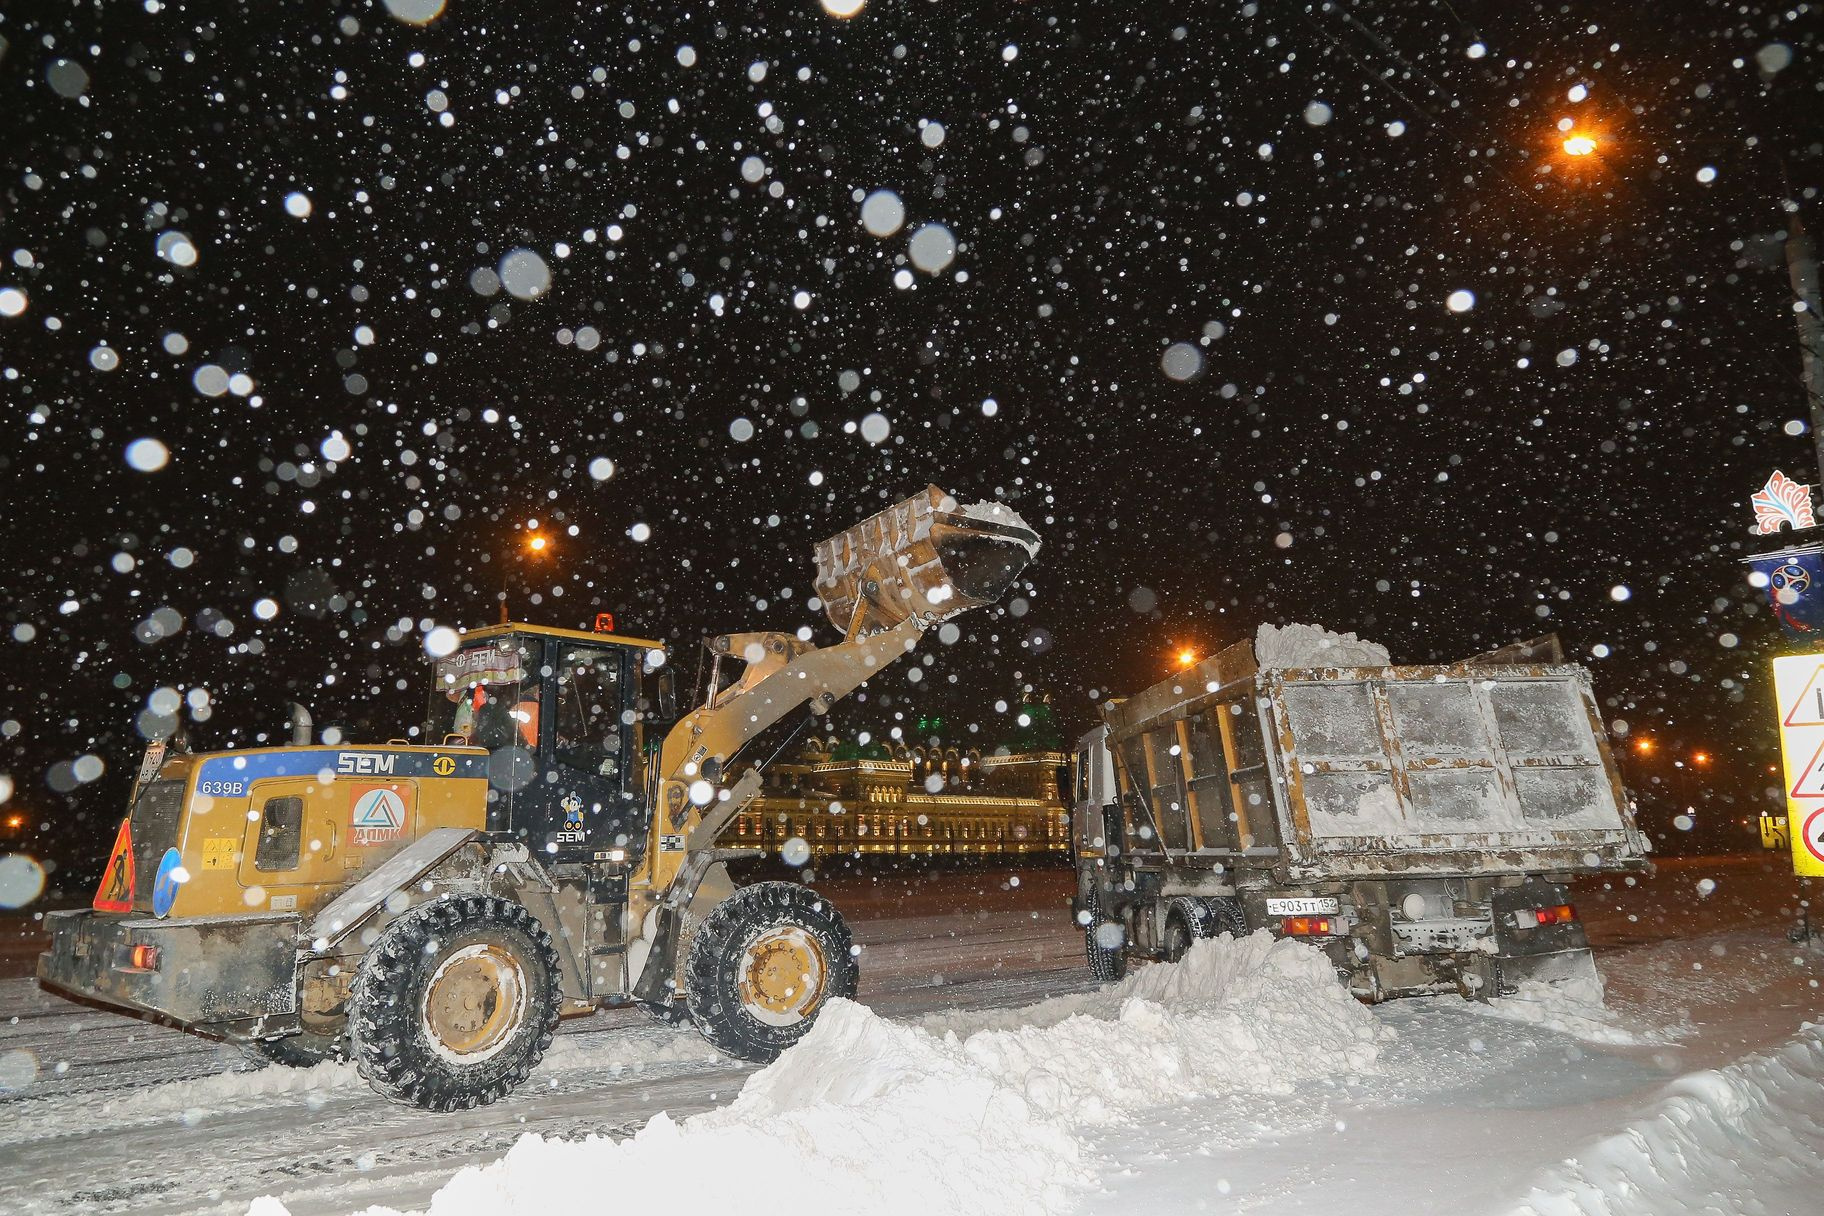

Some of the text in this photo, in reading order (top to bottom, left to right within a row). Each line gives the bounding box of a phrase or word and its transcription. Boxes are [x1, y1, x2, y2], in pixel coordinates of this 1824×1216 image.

[472, 649, 496, 666] SEM
[337, 752, 395, 774] SEM
[202, 781, 243, 795] 639B
[353, 828, 401, 844] ДПМК
[556, 831, 586, 843] SEM
[1318, 898, 1336, 908] 152
